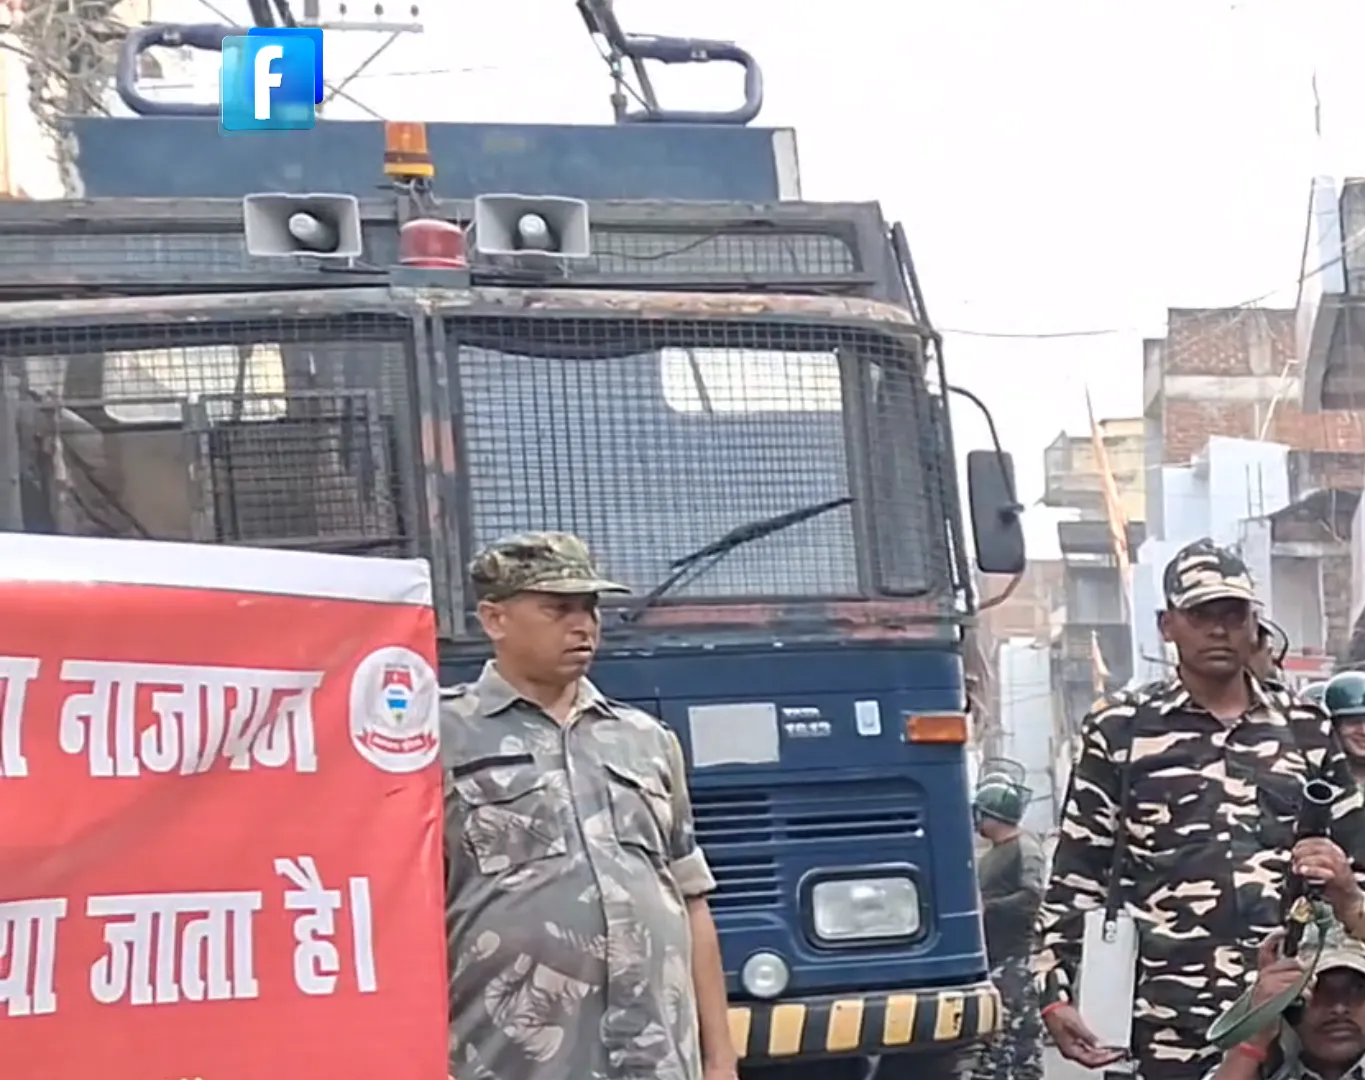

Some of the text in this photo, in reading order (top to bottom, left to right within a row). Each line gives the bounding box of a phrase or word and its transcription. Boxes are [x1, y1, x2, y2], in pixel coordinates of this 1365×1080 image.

[0, 855, 377, 1017] या जाता है।
